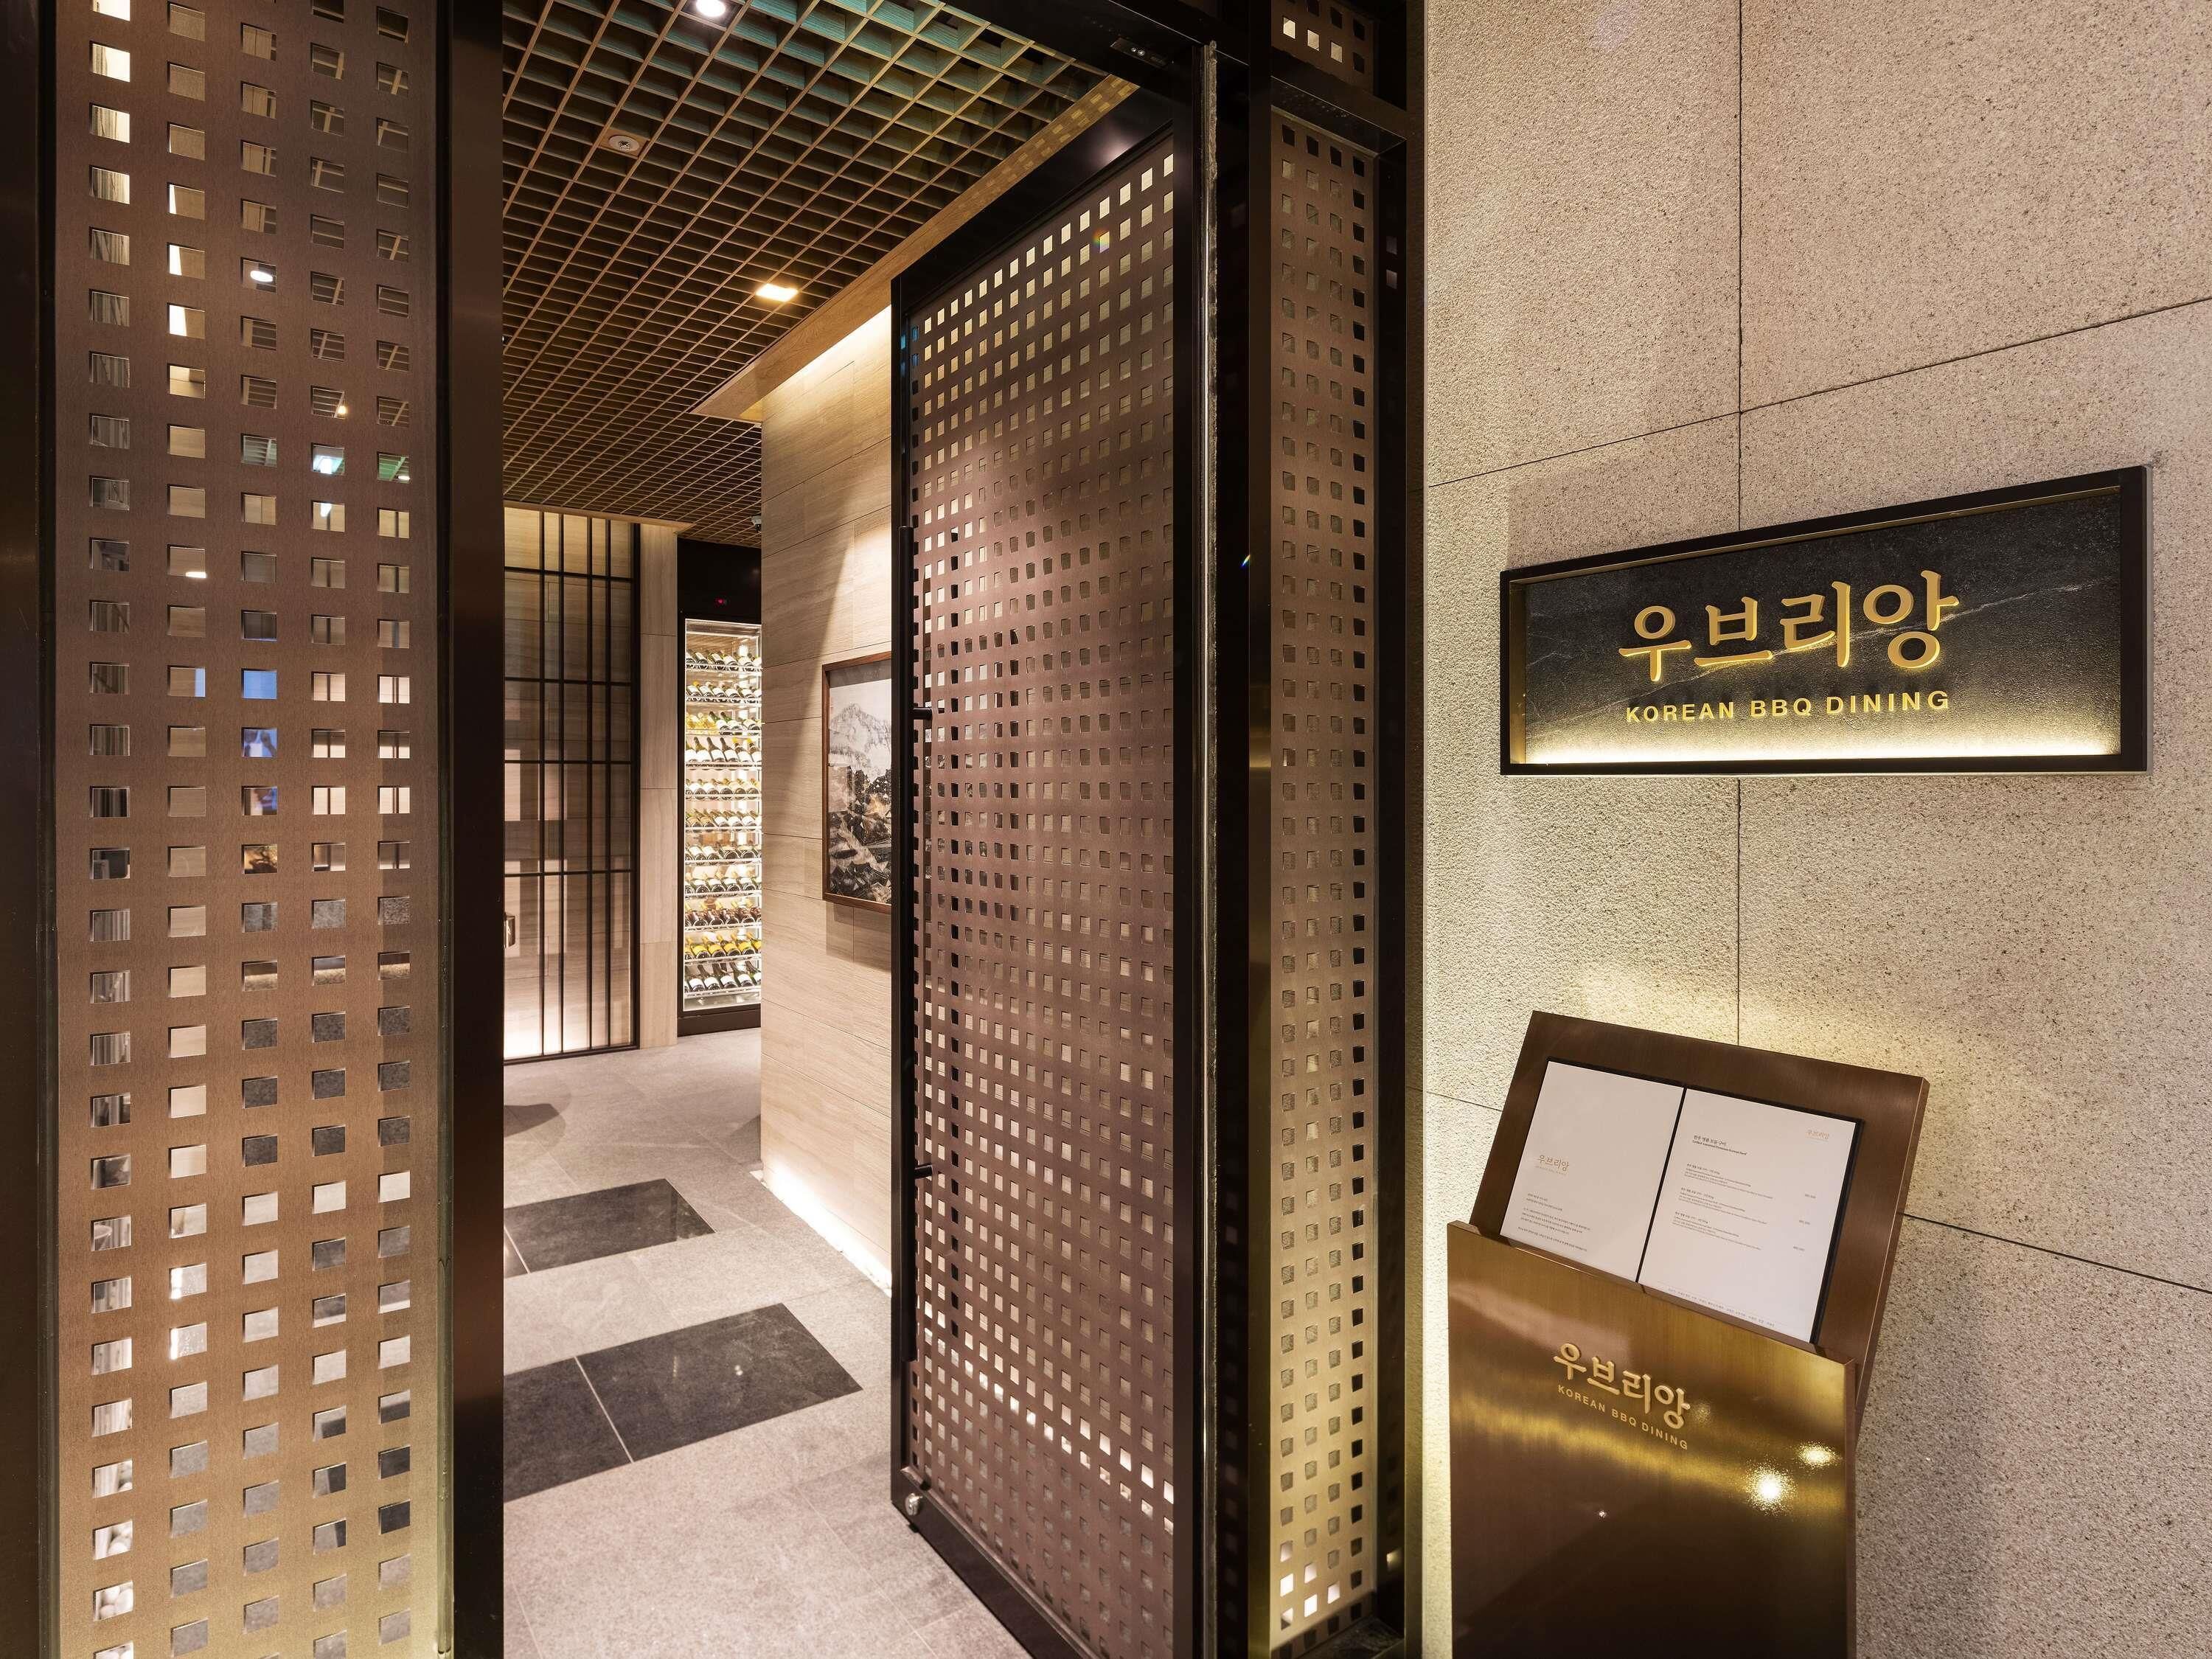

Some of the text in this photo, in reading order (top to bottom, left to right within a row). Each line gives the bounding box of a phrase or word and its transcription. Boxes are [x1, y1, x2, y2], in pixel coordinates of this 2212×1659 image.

[1618, 570, 1959, 682] 우브리앙
[1626, 690, 1949, 723] KOREAN BBQ DINING
[1553, 1343, 1691, 1429] 우브리앙
[1558, 1385, 1688, 1450] KOREAN BBQ DINING
